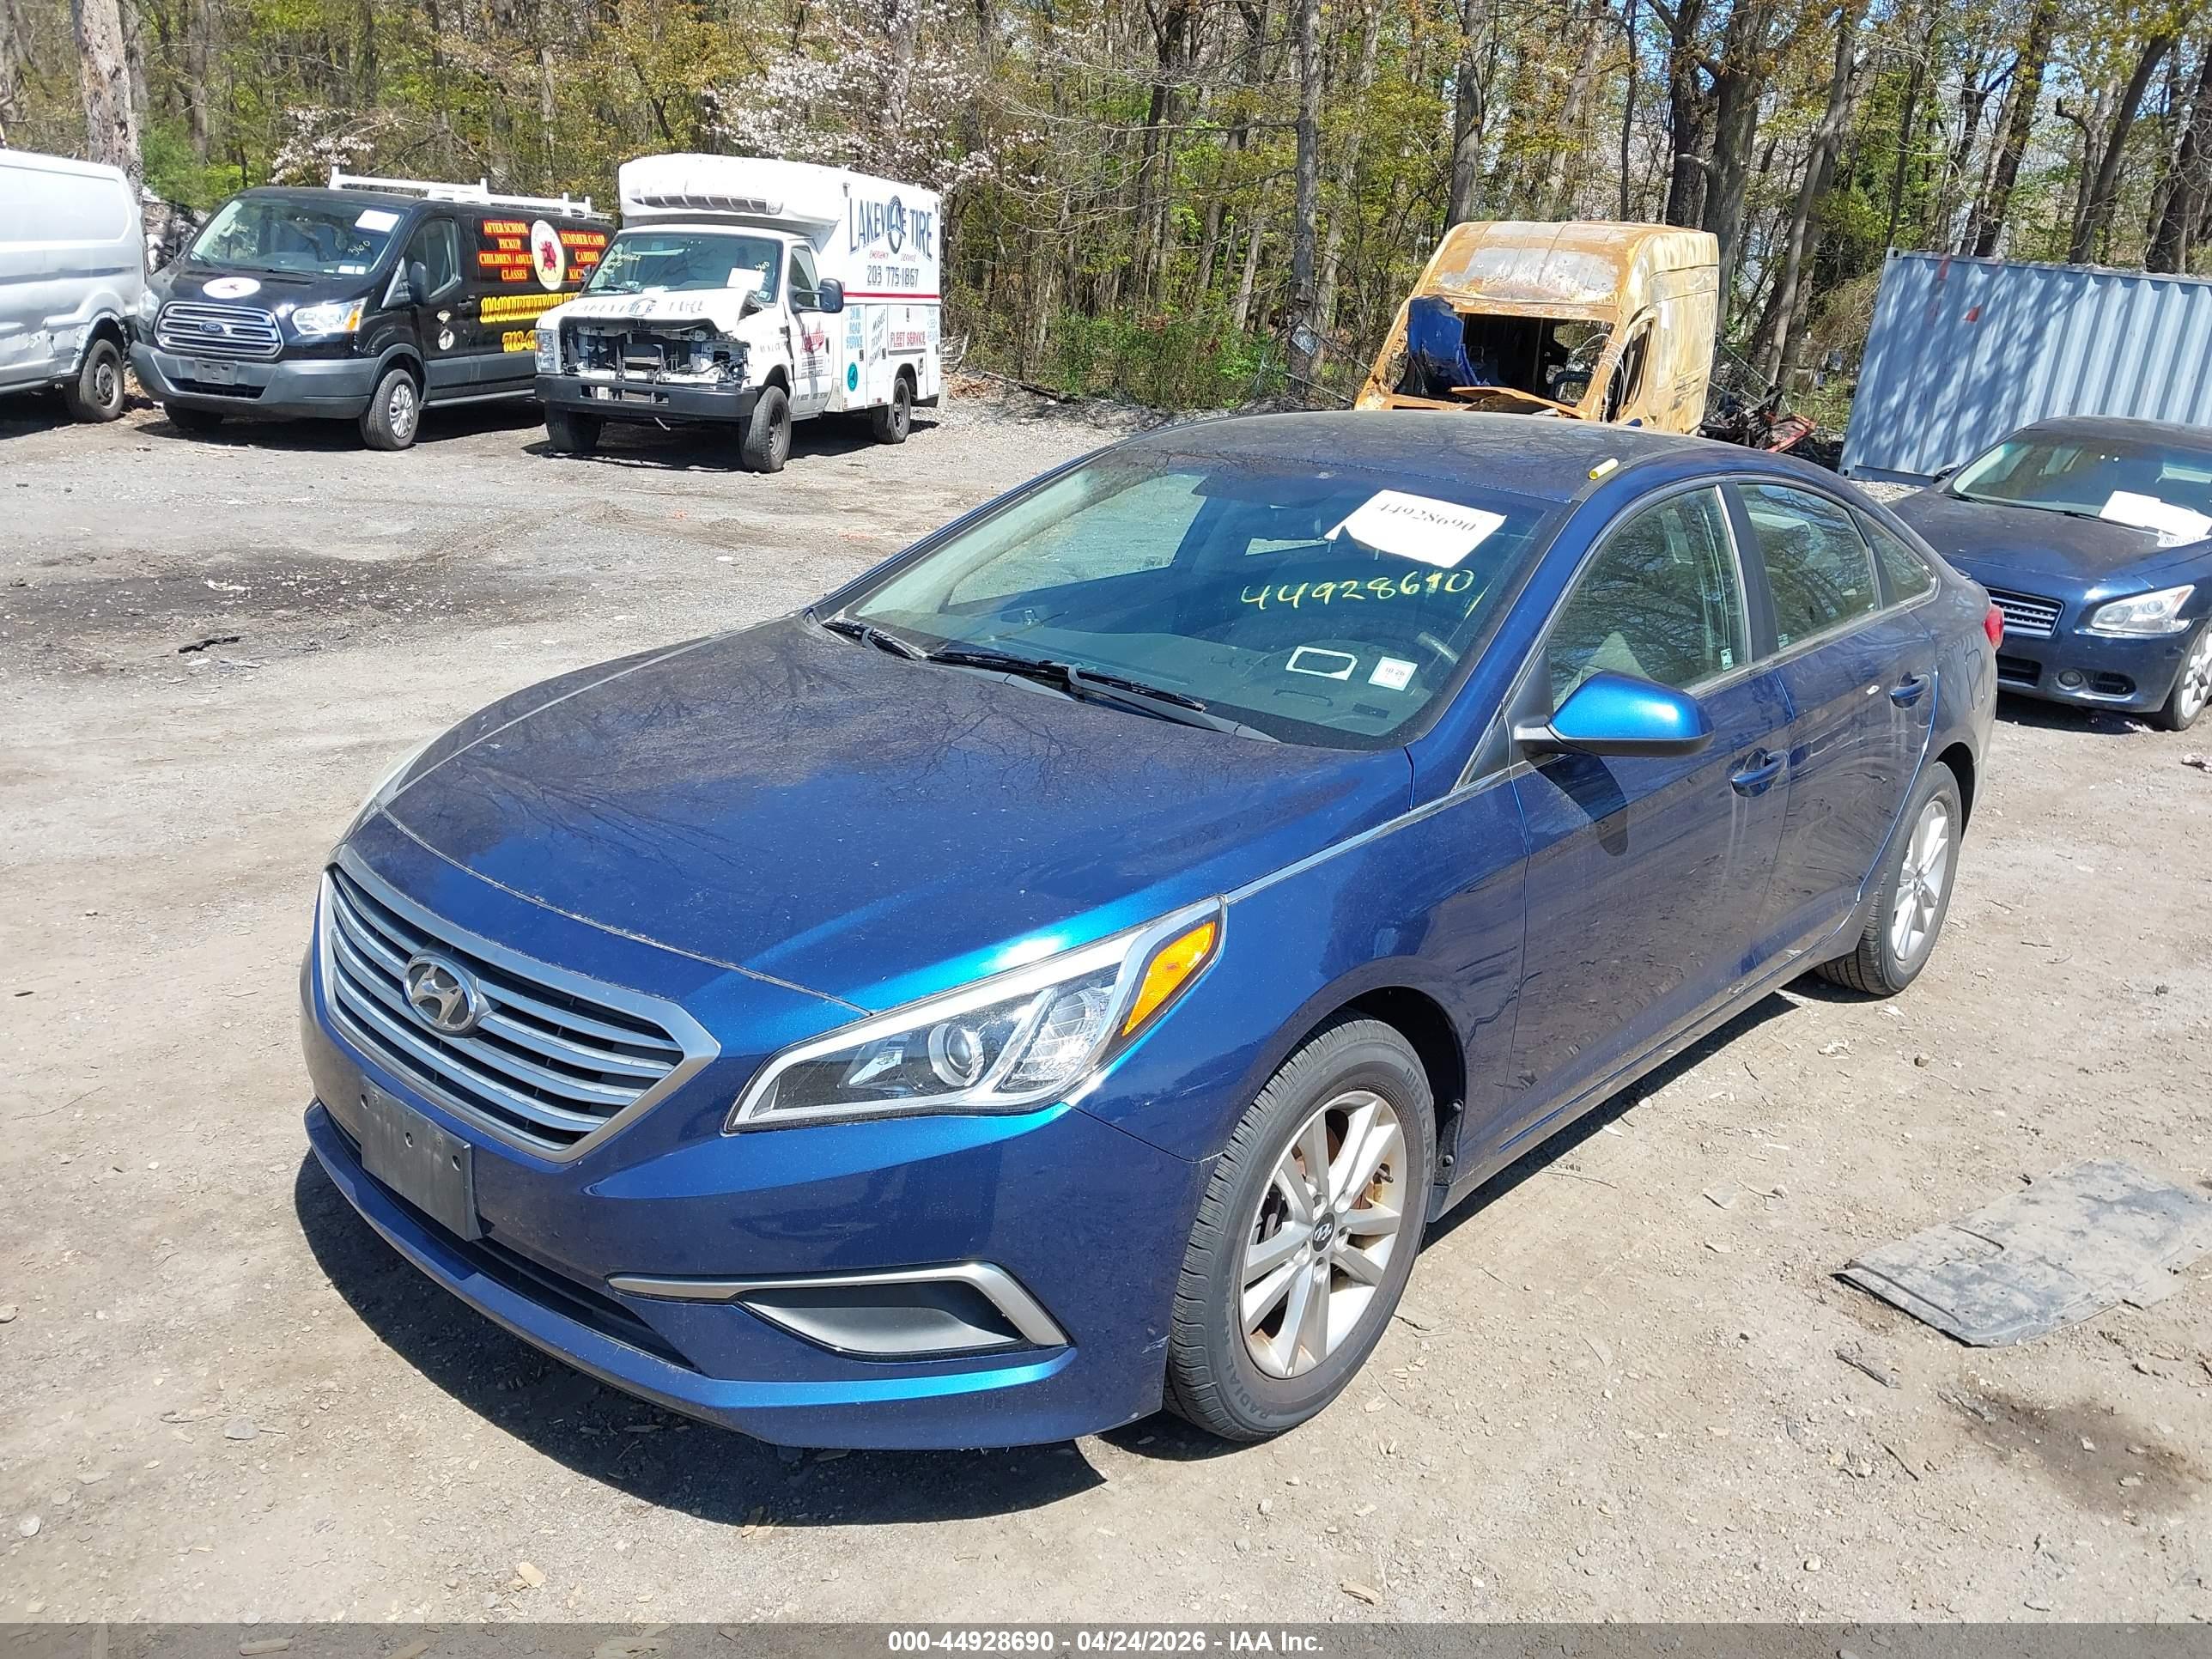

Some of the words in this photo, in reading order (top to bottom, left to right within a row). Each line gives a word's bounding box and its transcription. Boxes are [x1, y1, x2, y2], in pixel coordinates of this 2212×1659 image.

[483, 222, 504, 232] AFTER
[505, 222, 528, 234] SCHOOL
[849, 197, 907, 254] LAKEVILLE
[909, 208, 933, 261] TIRE
[498, 239, 521, 249] PICKUP
[561, 233, 588, 246] SUMMER
[589, 234, 606, 246] CAMP
[479, 253, 512, 264] CHILDREN
[575, 251, 599, 263] CARDIO
[501, 269, 527, 280] CLASSES
[866, 264, 882, 286] 203
[890, 331, 906, 348] FLEET
[907, 331, 927, 348] SERVICE
